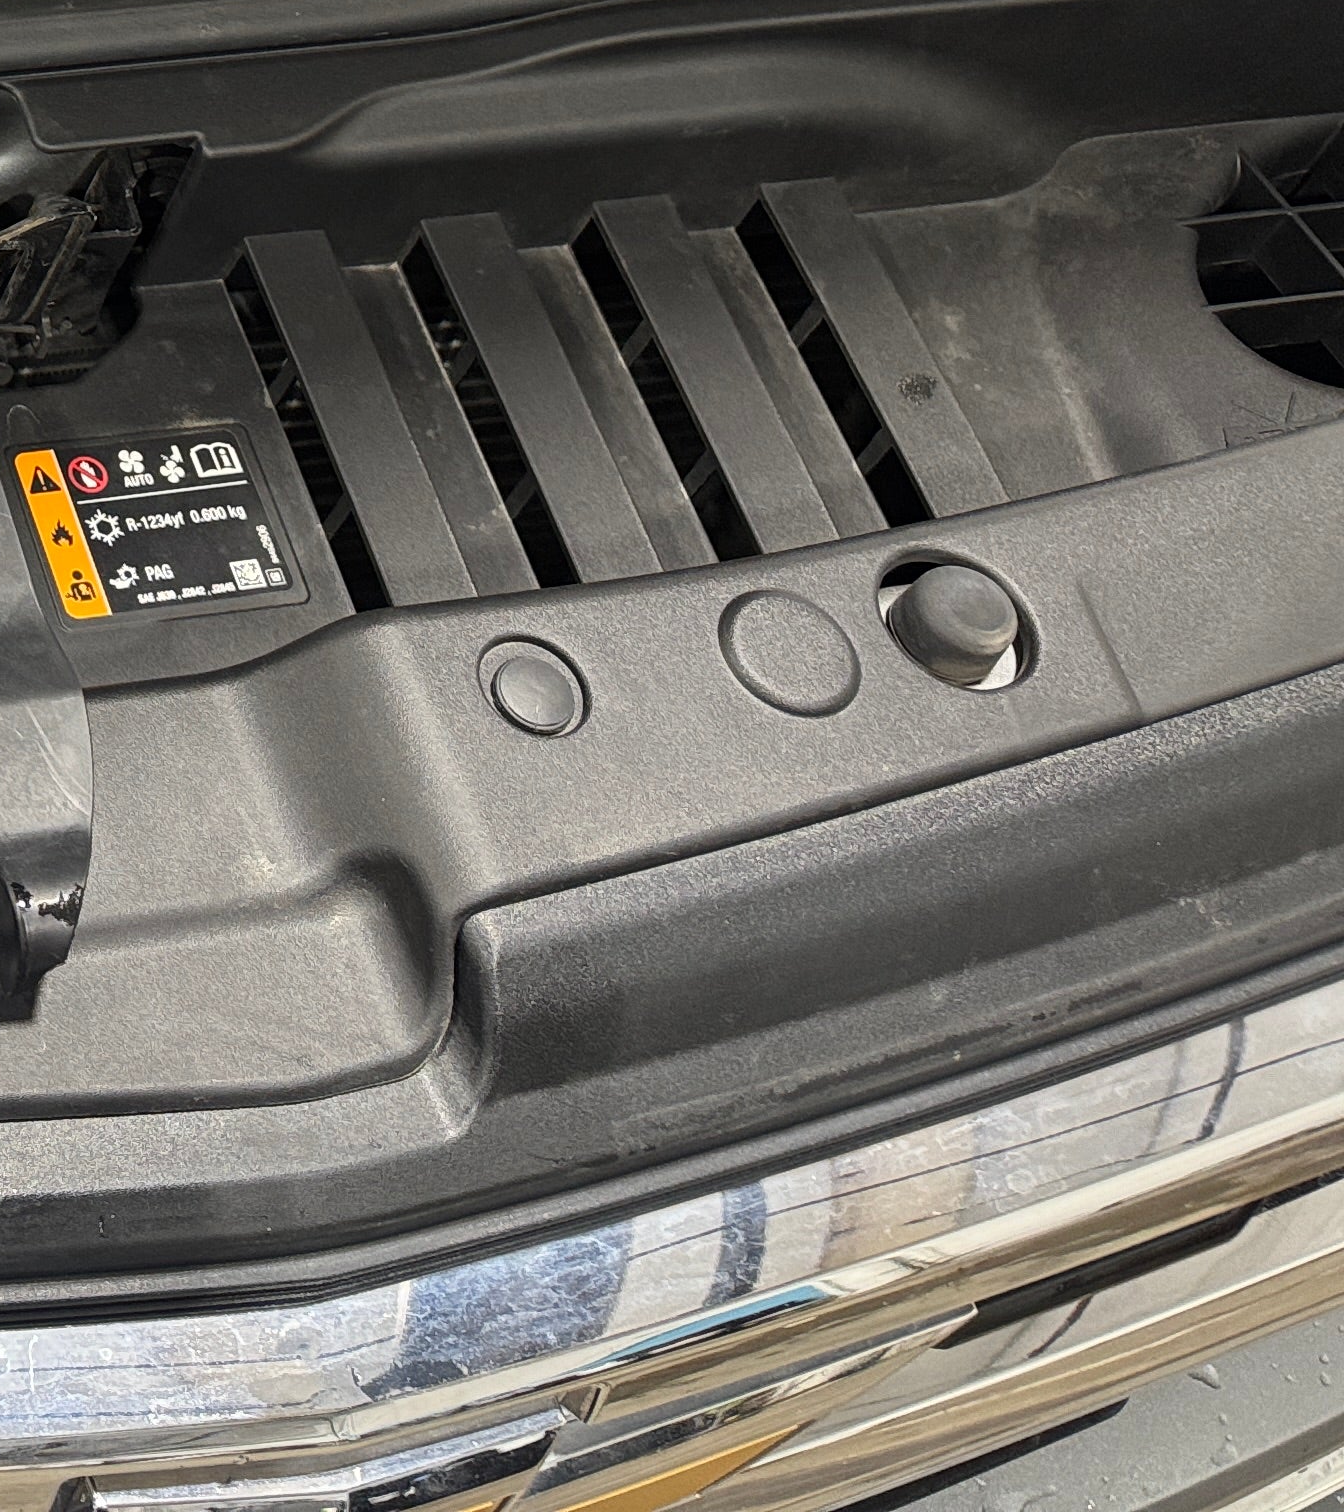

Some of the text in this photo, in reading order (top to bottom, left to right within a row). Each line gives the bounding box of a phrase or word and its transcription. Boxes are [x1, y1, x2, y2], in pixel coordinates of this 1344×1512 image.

[123, 473, 154, 488] AUTO
[125, 504, 248, 532] R-1234yf 0.600 kg
[144, 563, 175, 582] PAG
